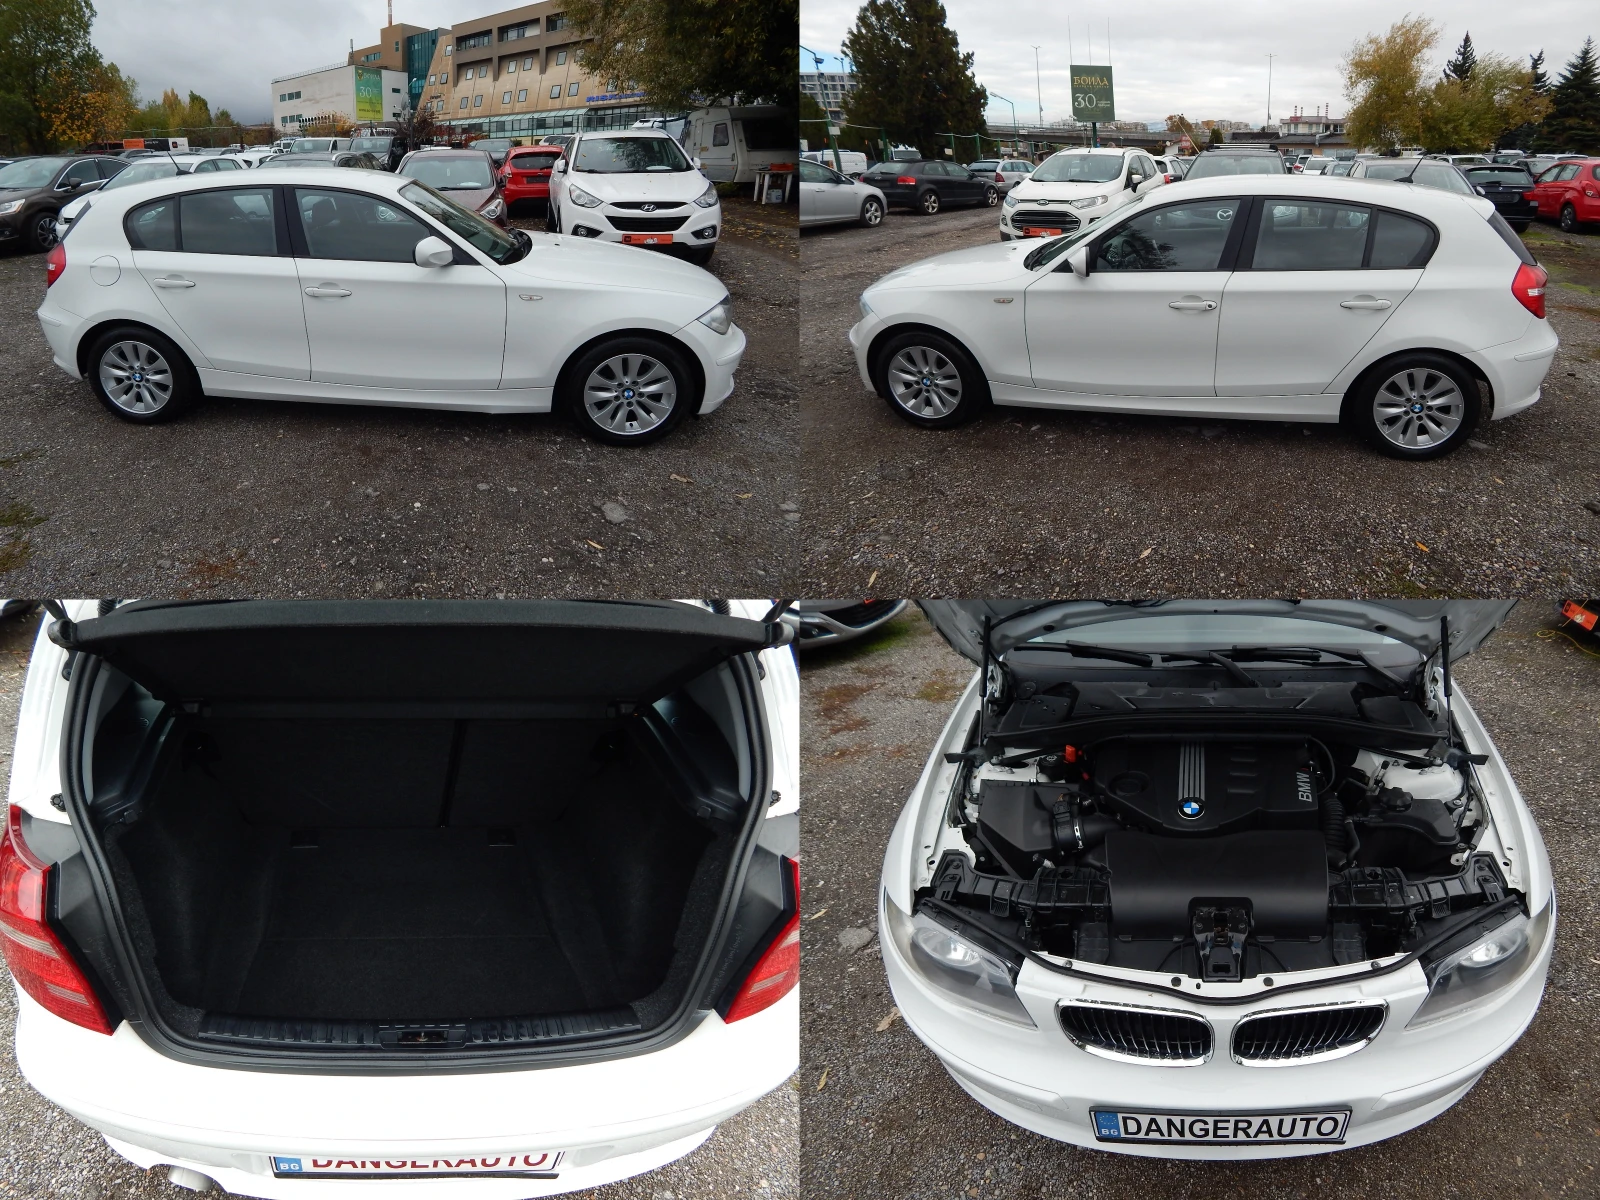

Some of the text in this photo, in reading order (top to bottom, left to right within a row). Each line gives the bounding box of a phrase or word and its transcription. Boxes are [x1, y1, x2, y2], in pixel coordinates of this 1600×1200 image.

[360, 86, 372, 98] 30
[1074, 93, 1096, 108] 30
[1296, 771, 1313, 802] BMW
[1101, 1115, 1339, 1139] BG DANGERAUTO
